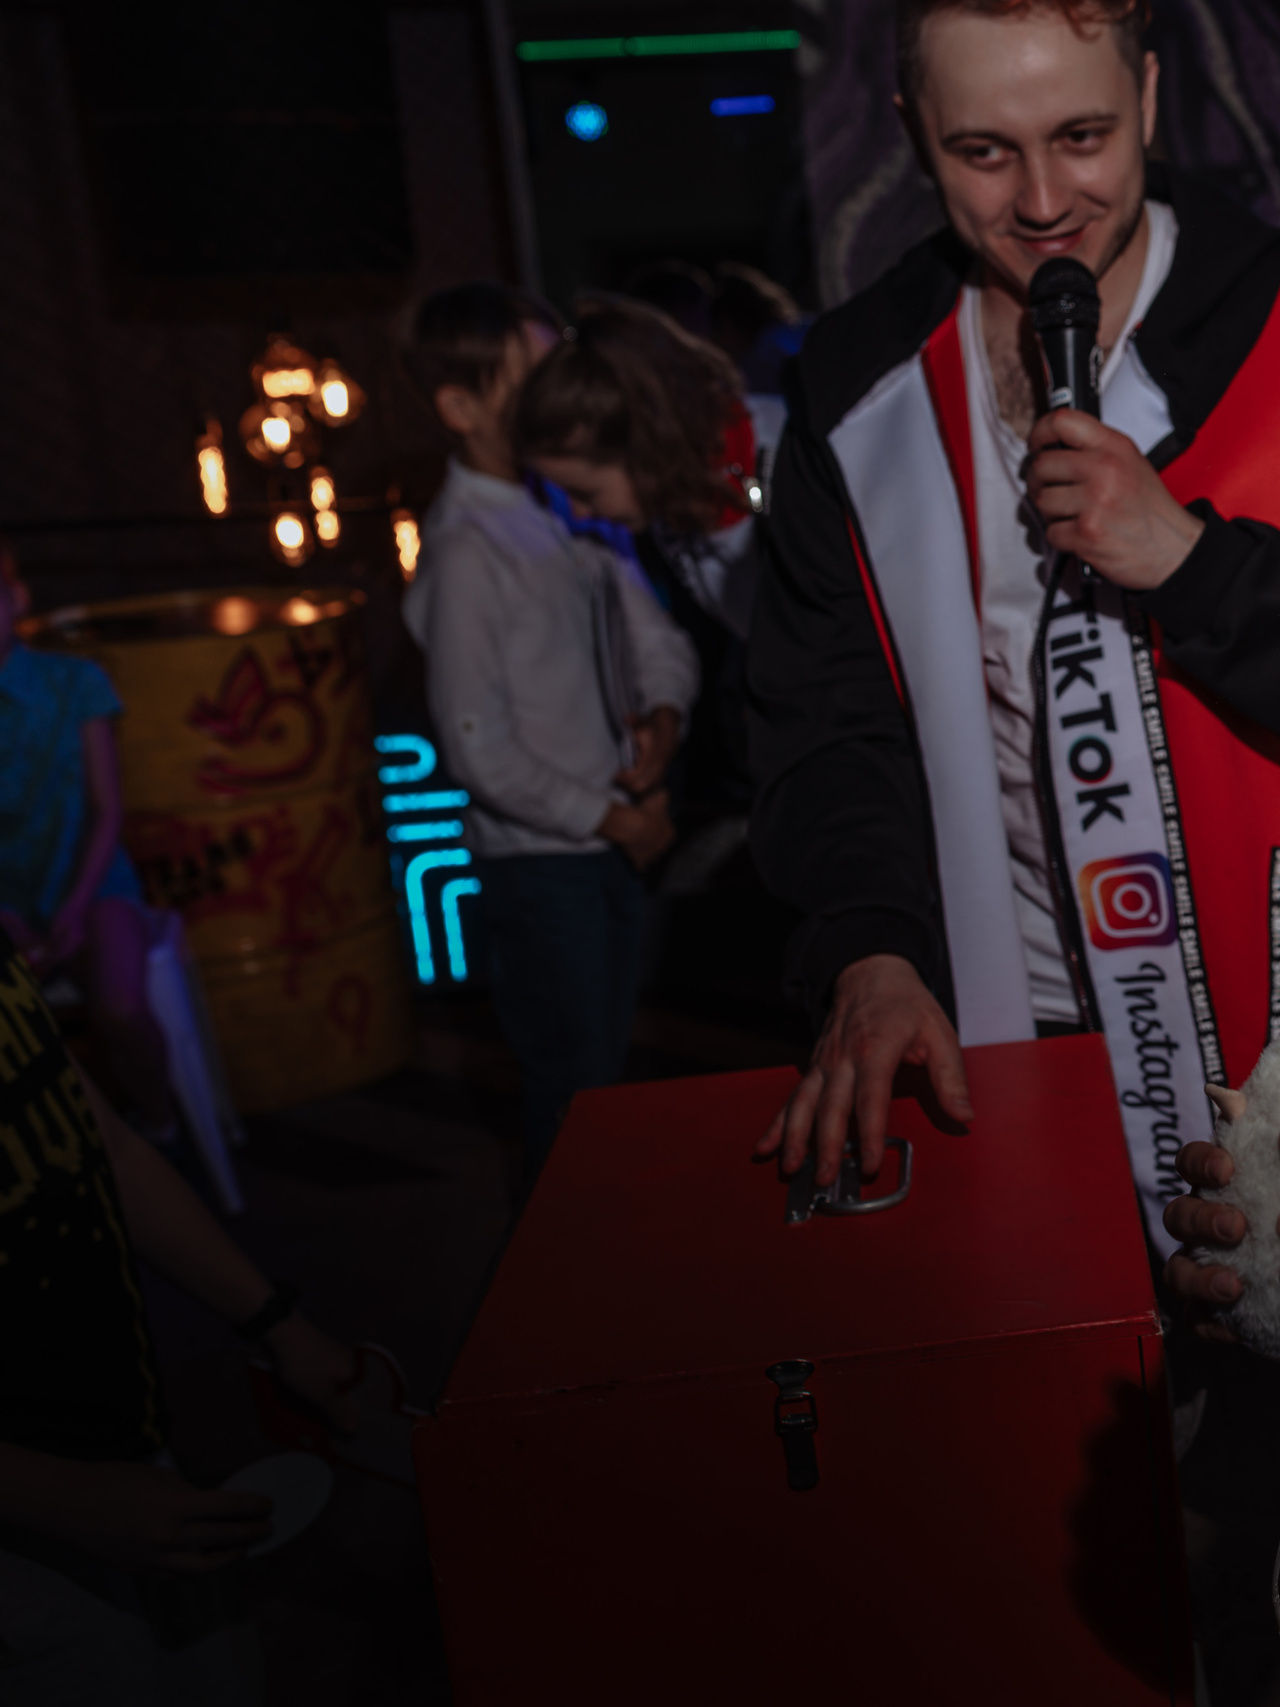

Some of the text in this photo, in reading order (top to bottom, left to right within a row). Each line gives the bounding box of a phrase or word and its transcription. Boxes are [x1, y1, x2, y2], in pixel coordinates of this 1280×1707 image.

[1135, 650, 1157, 704] SMILE
[1051, 583, 1129, 833] TikTok
[1143, 706, 1168, 760] SMILE
[1155, 764, 1178, 816] SMILE
[1166, 820, 1187, 871] SMILE
[1172, 875, 1195, 926] SMILE
[1179, 931, 1204, 979] SMILE
[1190, 982, 1215, 1032] SMILE
[1114, 962, 1186, 1198] Instagram
[1200, 1033, 1225, 1082] SMILE
